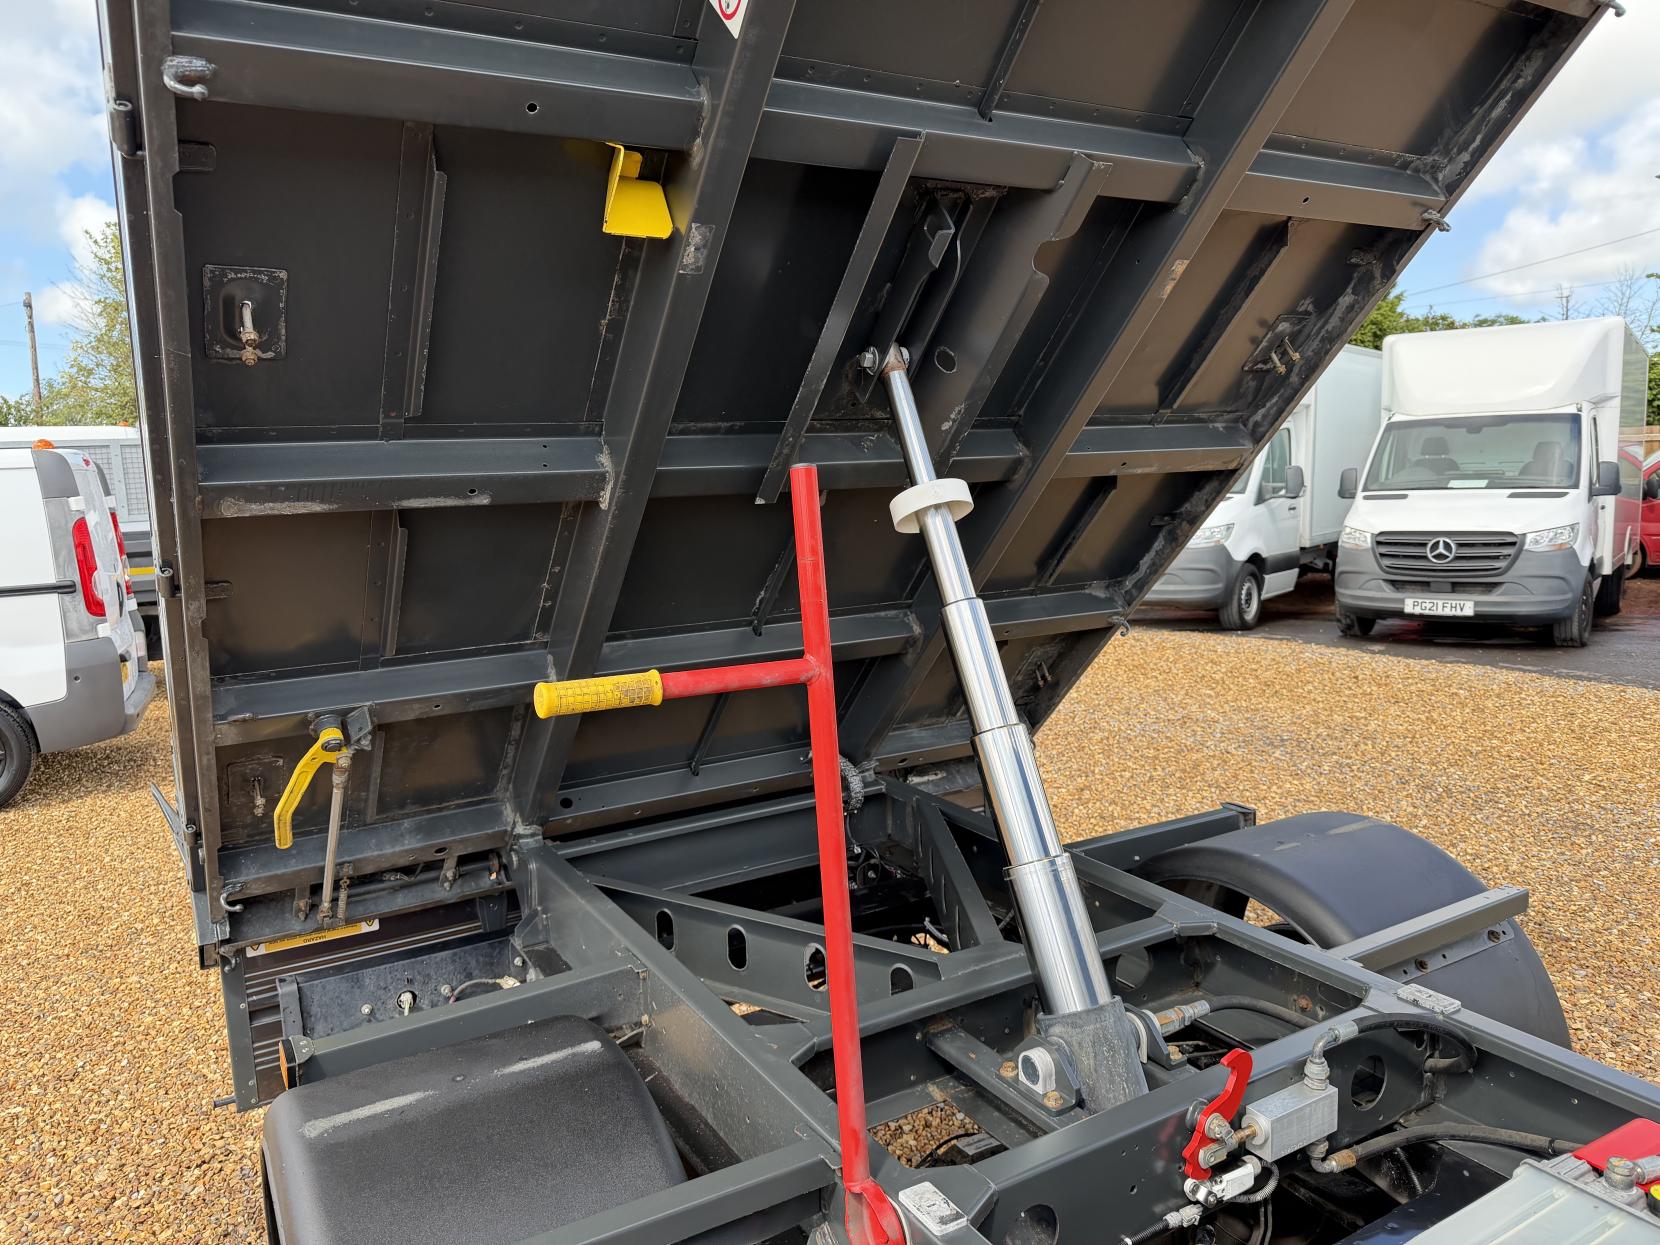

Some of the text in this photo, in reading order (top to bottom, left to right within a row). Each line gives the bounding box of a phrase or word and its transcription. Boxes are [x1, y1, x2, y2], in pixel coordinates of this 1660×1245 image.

[1412, 601, 1466, 612] PG21 FHV
[303, 934, 326, 943] HAZARD
